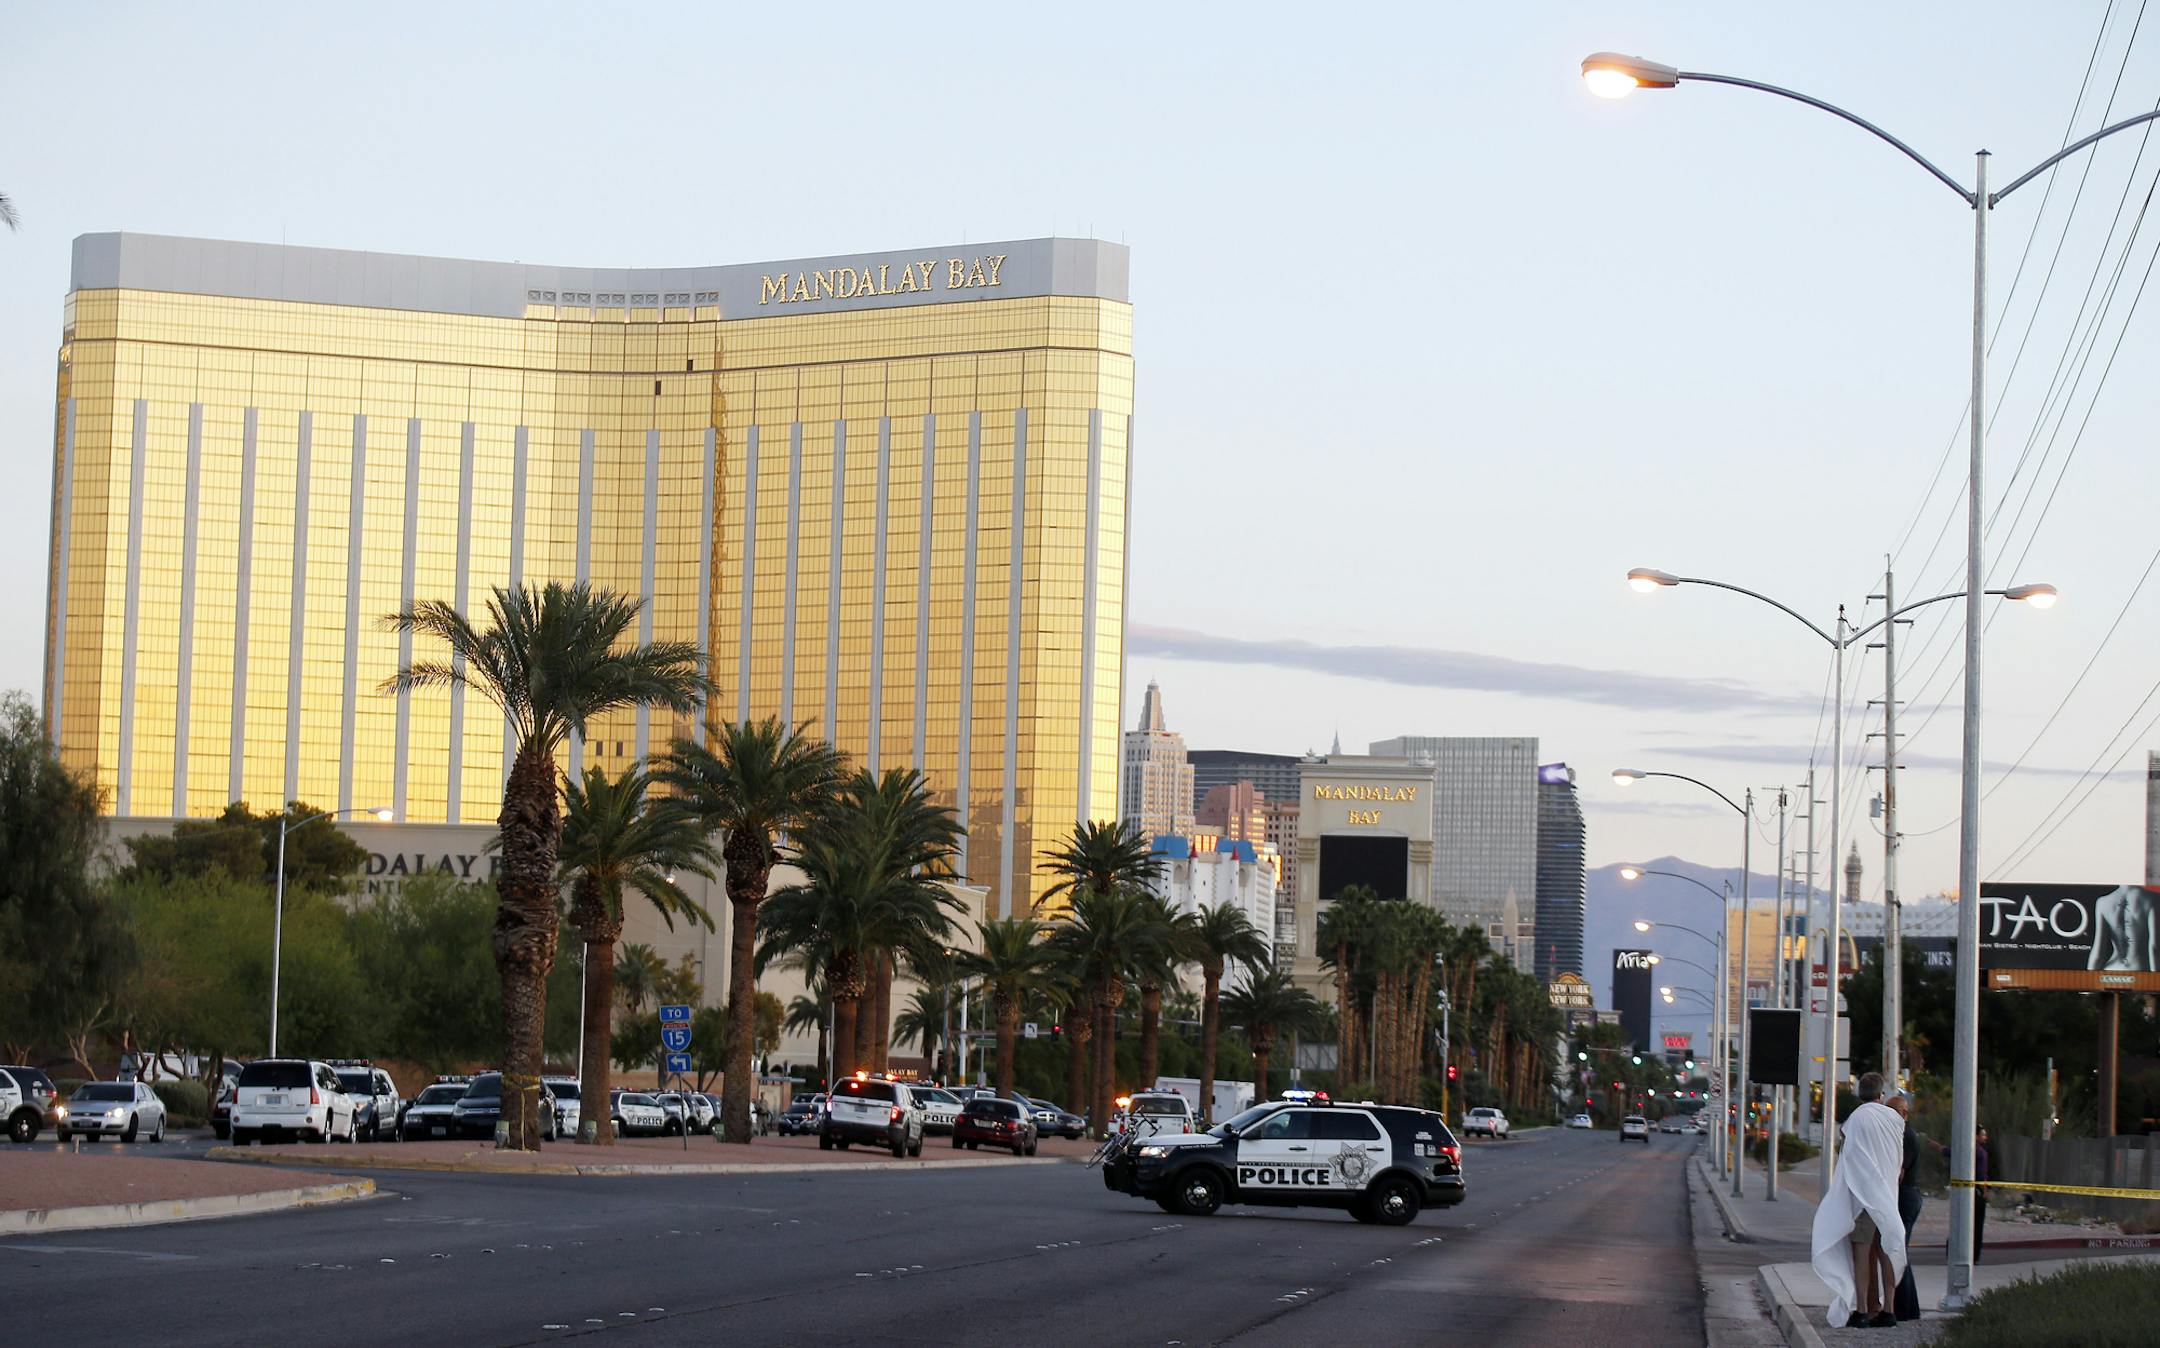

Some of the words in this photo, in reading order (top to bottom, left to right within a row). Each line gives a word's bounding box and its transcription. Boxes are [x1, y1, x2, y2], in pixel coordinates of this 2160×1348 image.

[758, 260, 937, 305] MANDALAY
[946, 254, 1007, 290] BAY
[1314, 784, 1417, 801] MANDALAY
[1348, 809, 1381, 824] BAY
[365, 852, 478, 877] DALAY
[1980, 894, 2088, 939] TAO
[1616, 951, 1649, 969] Aria
[1549, 984, 1567, 994] NEW
[1568, 984, 1589, 994] YORK
[1549, 995, 1567, 1005] NEW
[1568, 995, 1589, 1005] YORK
[667, 1008, 682, 1018] TO
[668, 1031, 685, 1046] 15
[924, 1114, 957, 1124] POLIC
[1239, 1168, 1330, 1185] POLICE
[2088, 1239, 2102, 1248] NO
